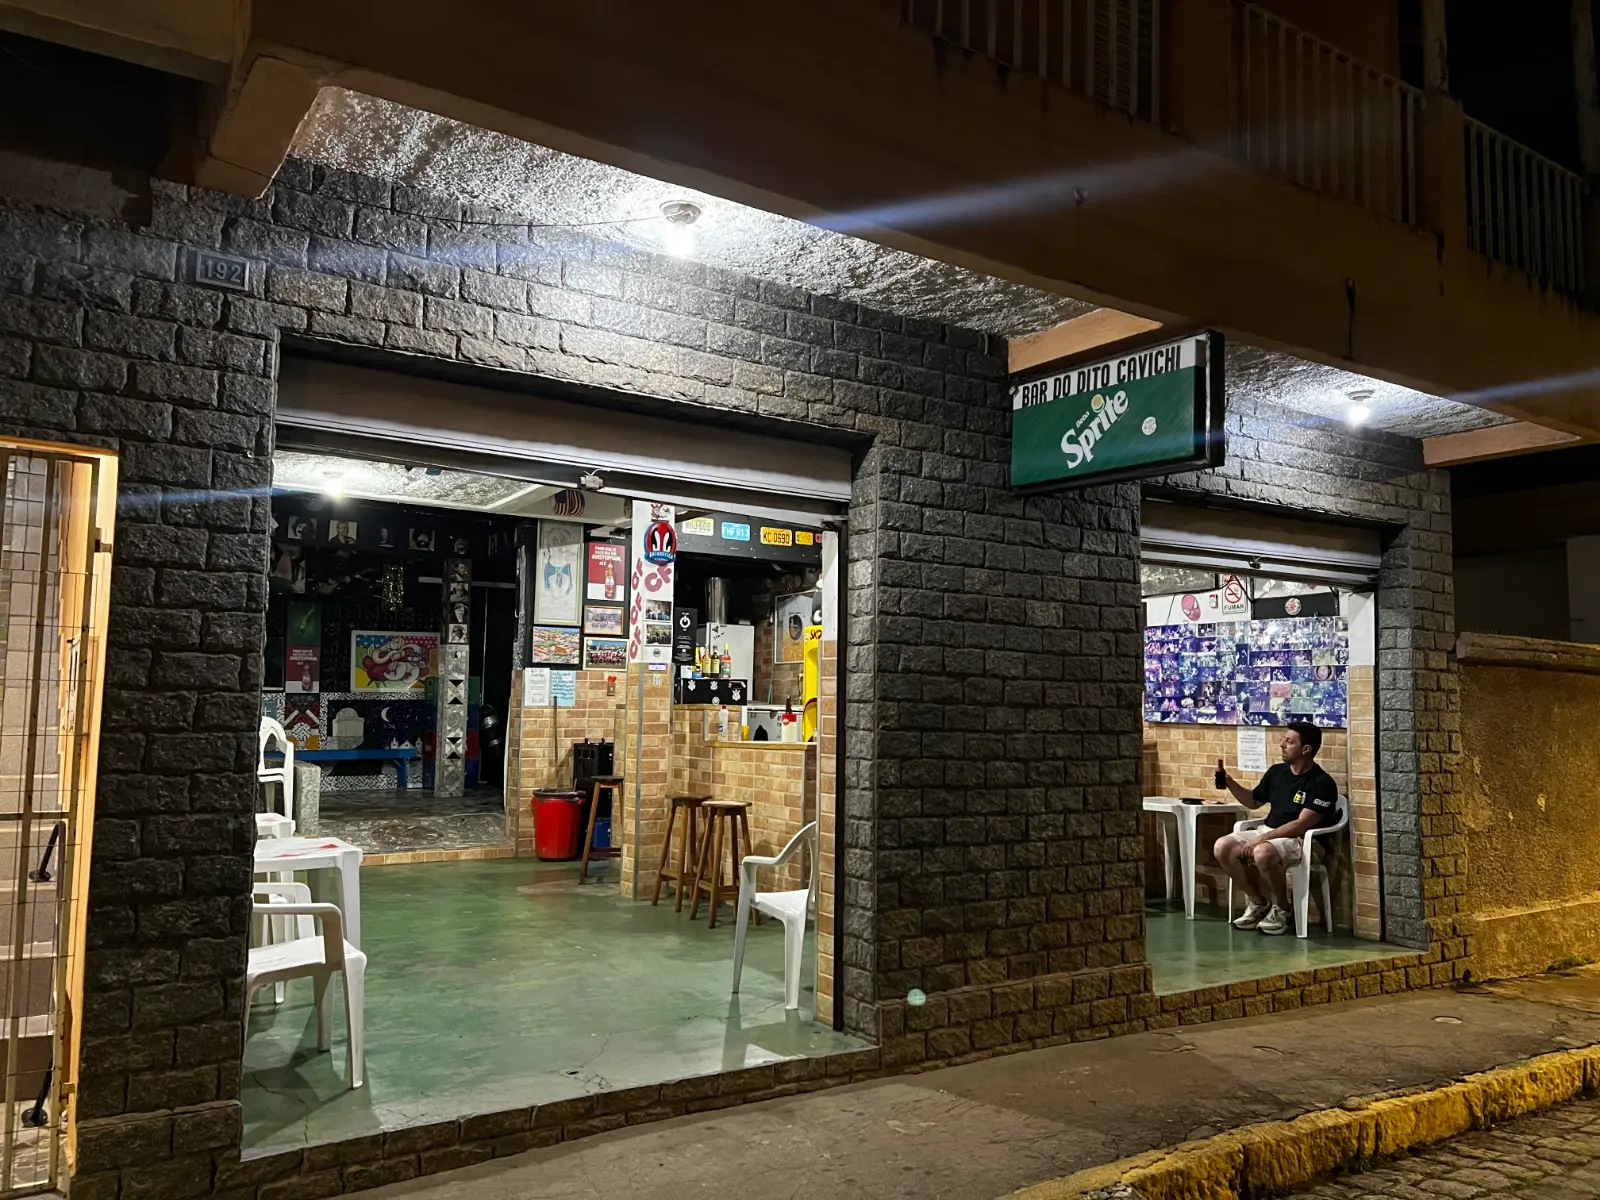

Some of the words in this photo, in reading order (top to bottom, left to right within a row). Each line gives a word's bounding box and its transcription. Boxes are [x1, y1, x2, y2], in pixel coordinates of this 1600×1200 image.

[206, 259, 241, 282] 192
[1022, 381, 1048, 408] BAR
[1053, 375, 1071, 399] DO
[1077, 364, 1110, 393] DITO
[1117, 345, 1181, 383] CAVICHI
[1061, 390, 1129, 469] Sprite
[1224, 603, 1245, 611] FUMAR
